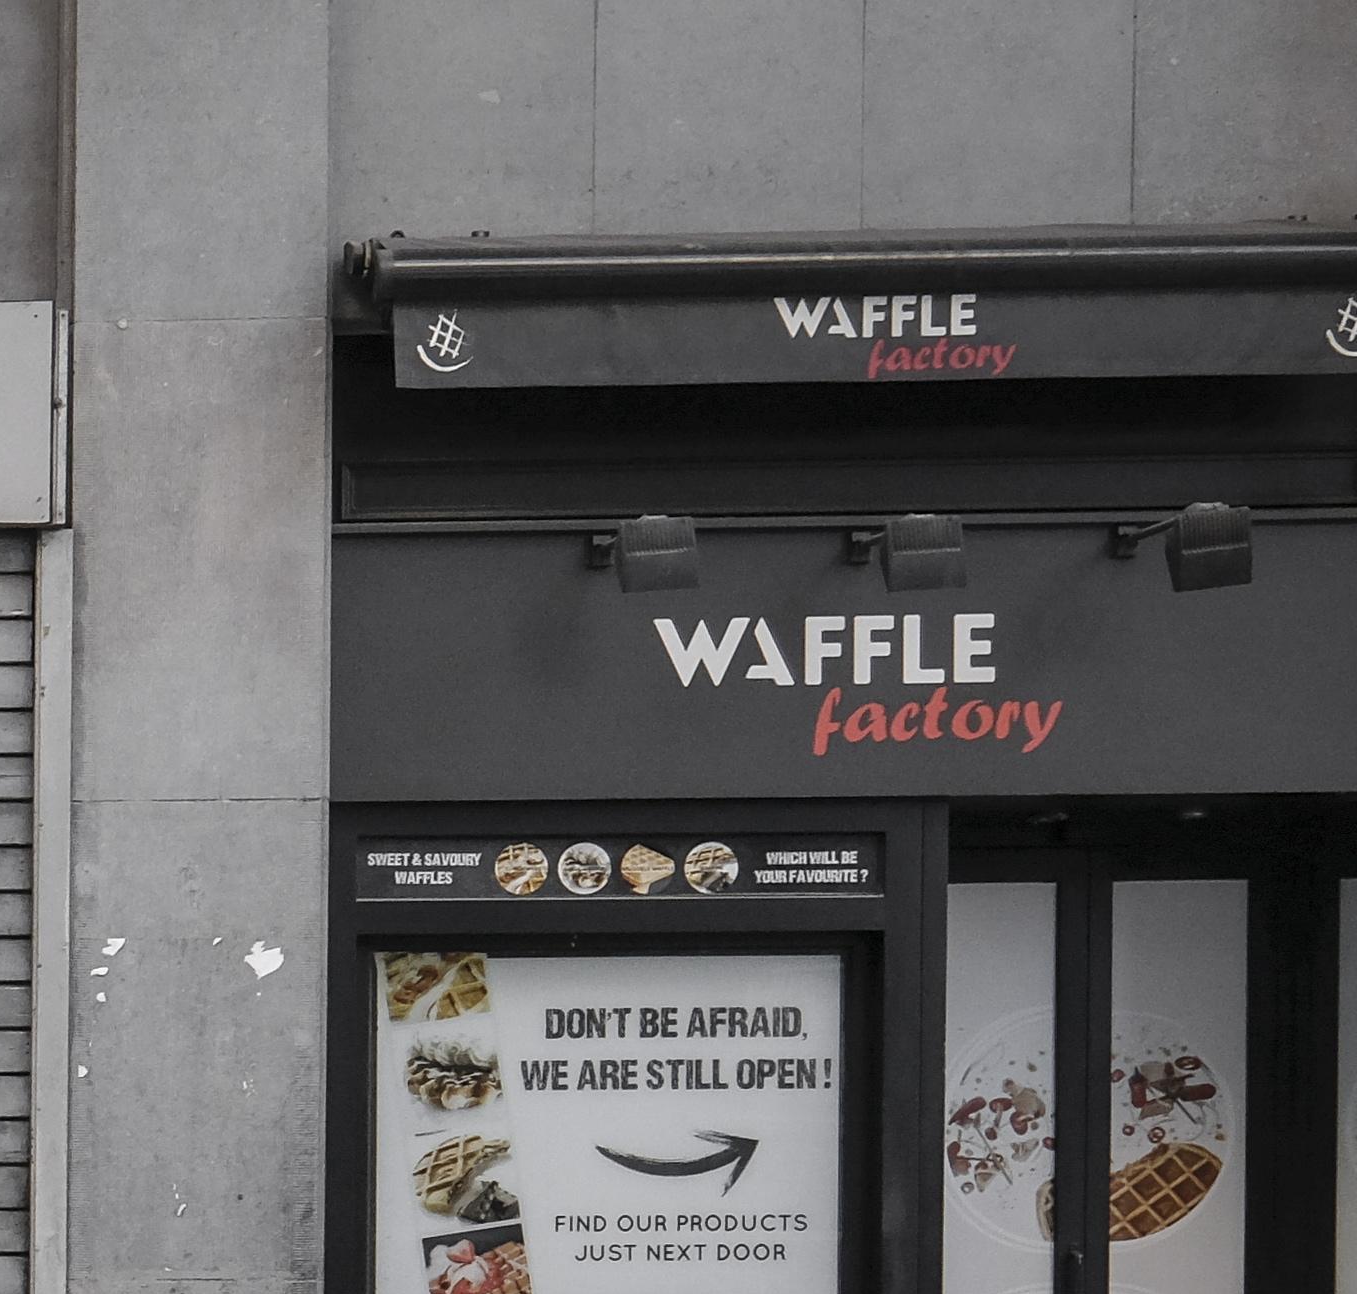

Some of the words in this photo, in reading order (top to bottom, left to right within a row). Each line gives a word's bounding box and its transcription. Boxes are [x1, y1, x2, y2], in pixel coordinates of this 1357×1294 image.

[773, 294, 977, 338] WAFFLE
[868, 338, 1017, 379] factory
[653, 613, 996, 687] WAFFLE
[813, 687, 1063, 756] factory
[367, 852, 411, 866] SWEET
[412, 852, 423, 866] &
[424, 852, 483, 866] SAVOURY
[766, 851, 808, 865] WHICH
[809, 851, 840, 865] WILL
[841, 850, 858, 864] BE
[394, 871, 453, 885] WAFFLES
[754, 870, 788, 883] YOUR
[789, 869, 858, 883] FAVOURITE
[545, 1007, 632, 1039] DON'T
[639, 1007, 678, 1038] BE
[686, 1006, 808, 1041] AFRAID,
[521, 1060, 568, 1090] WE
[577, 1059, 638, 1090] ARE
[646, 1059, 729, 1090] STILL
[555, 1215, 607, 1232] FIND
[617, 1214, 667, 1232] OUR
[677, 1214, 808, 1231] PRODUCTS
[575, 1244, 637, 1261] JUST
[647, 1244, 707, 1261] NEXT
[717, 1243, 787, 1261] DOOR
